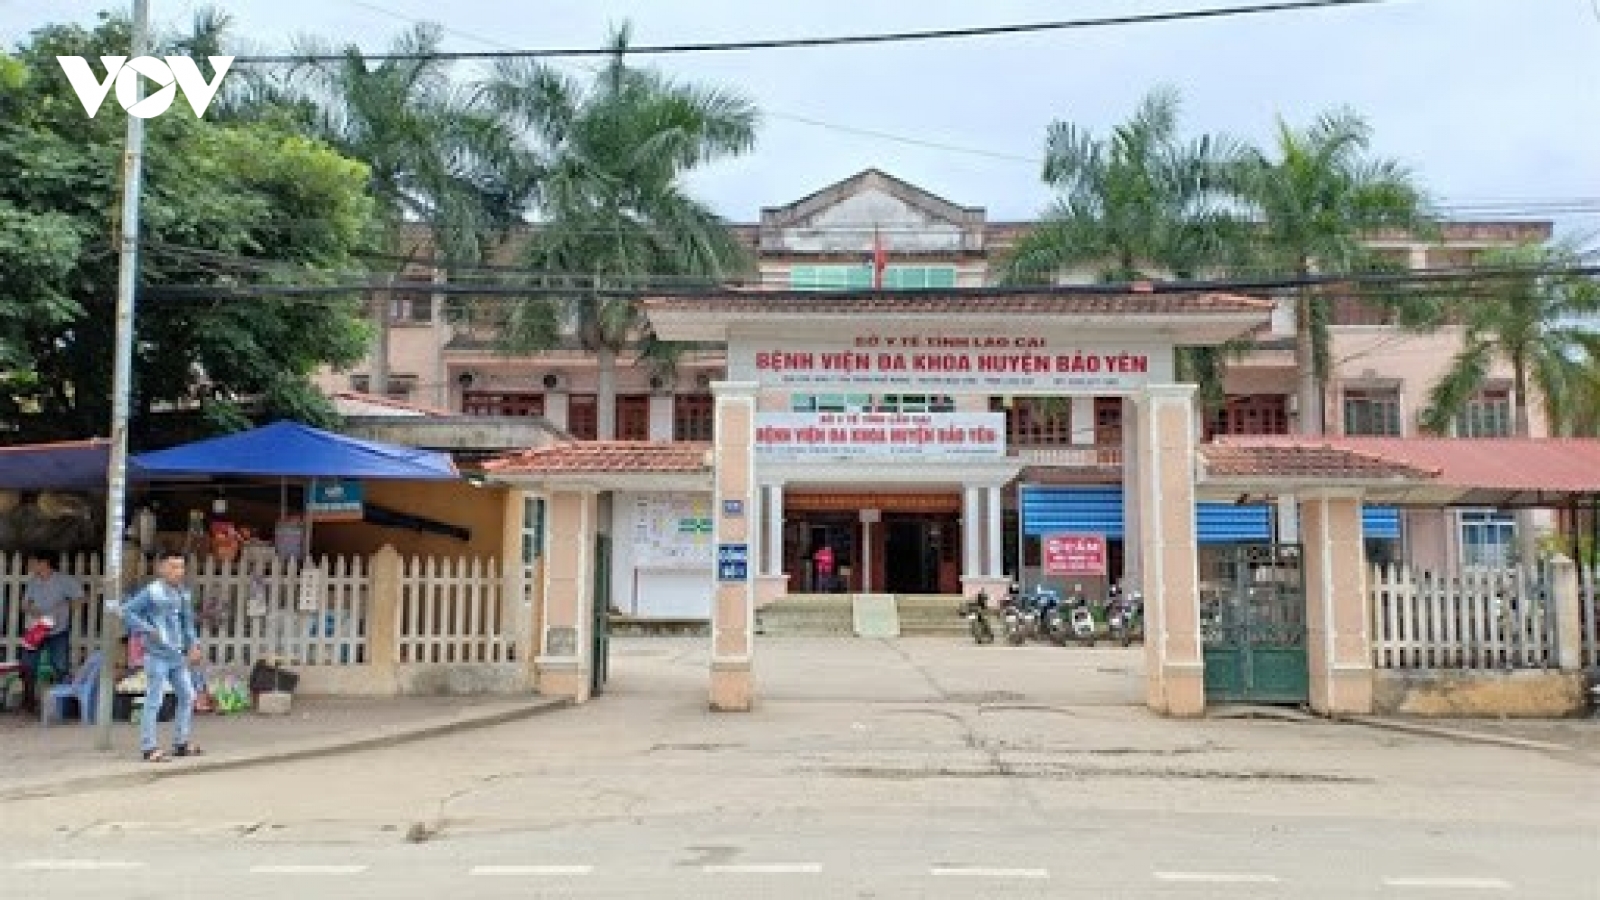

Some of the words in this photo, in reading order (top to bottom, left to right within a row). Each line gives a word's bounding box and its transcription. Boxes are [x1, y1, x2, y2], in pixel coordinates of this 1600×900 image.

[756, 350, 814, 372] BỆNH
[821, 350, 869, 373] VIỆN
[913, 354, 970, 372] KHOA
[977, 350, 1050, 375] HUYỆN
[1055, 350, 1100, 373] BẢO
[1103, 350, 1148, 373] YÊN
[756, 425, 791, 449] BỆNH
[794, 425, 825, 446] VIỆN
[850, 428, 886, 444] KHOA
[890, 425, 935, 448] HUYỆN
[968, 425, 996, 444] YÊN
